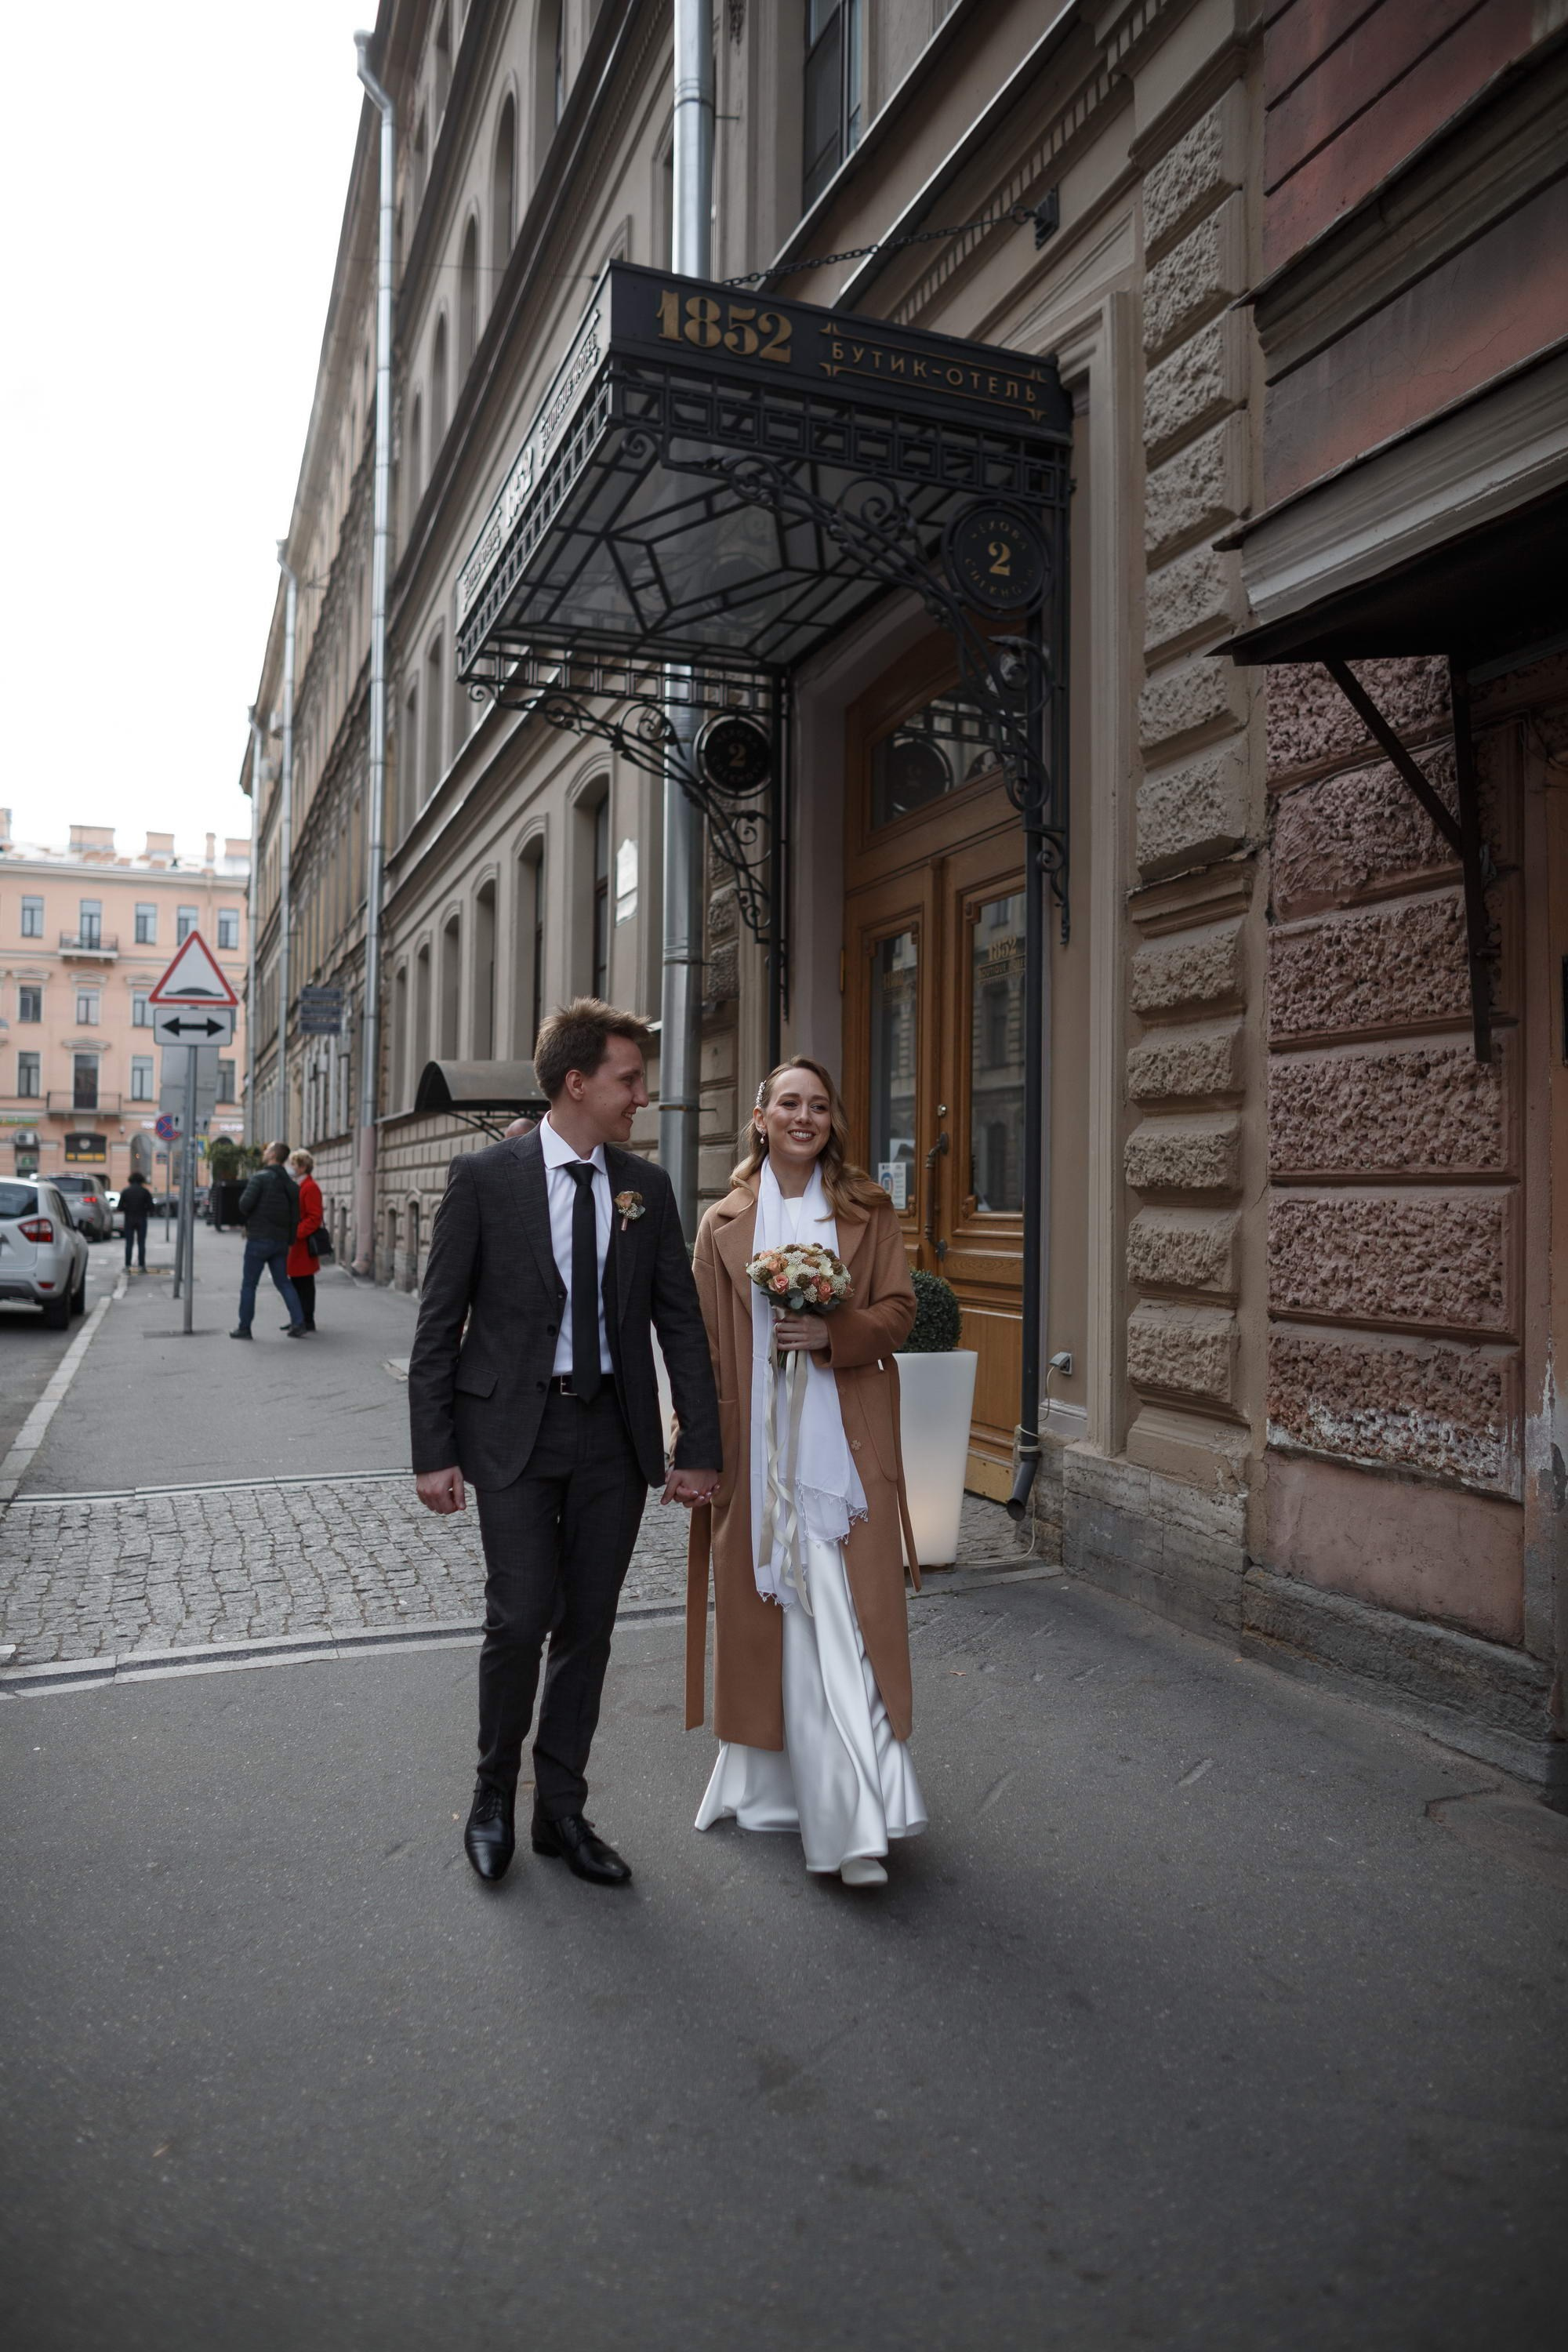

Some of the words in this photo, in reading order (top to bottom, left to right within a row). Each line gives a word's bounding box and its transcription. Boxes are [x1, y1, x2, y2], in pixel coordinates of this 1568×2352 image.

[656, 290, 792, 362] 1852
[832, 342, 1036, 401] БУТИК-ОТЕЛЬ
[989, 541, 1011, 576] 2
[728, 742, 746, 767] 2
[989, 934, 1017, 961] 1852
